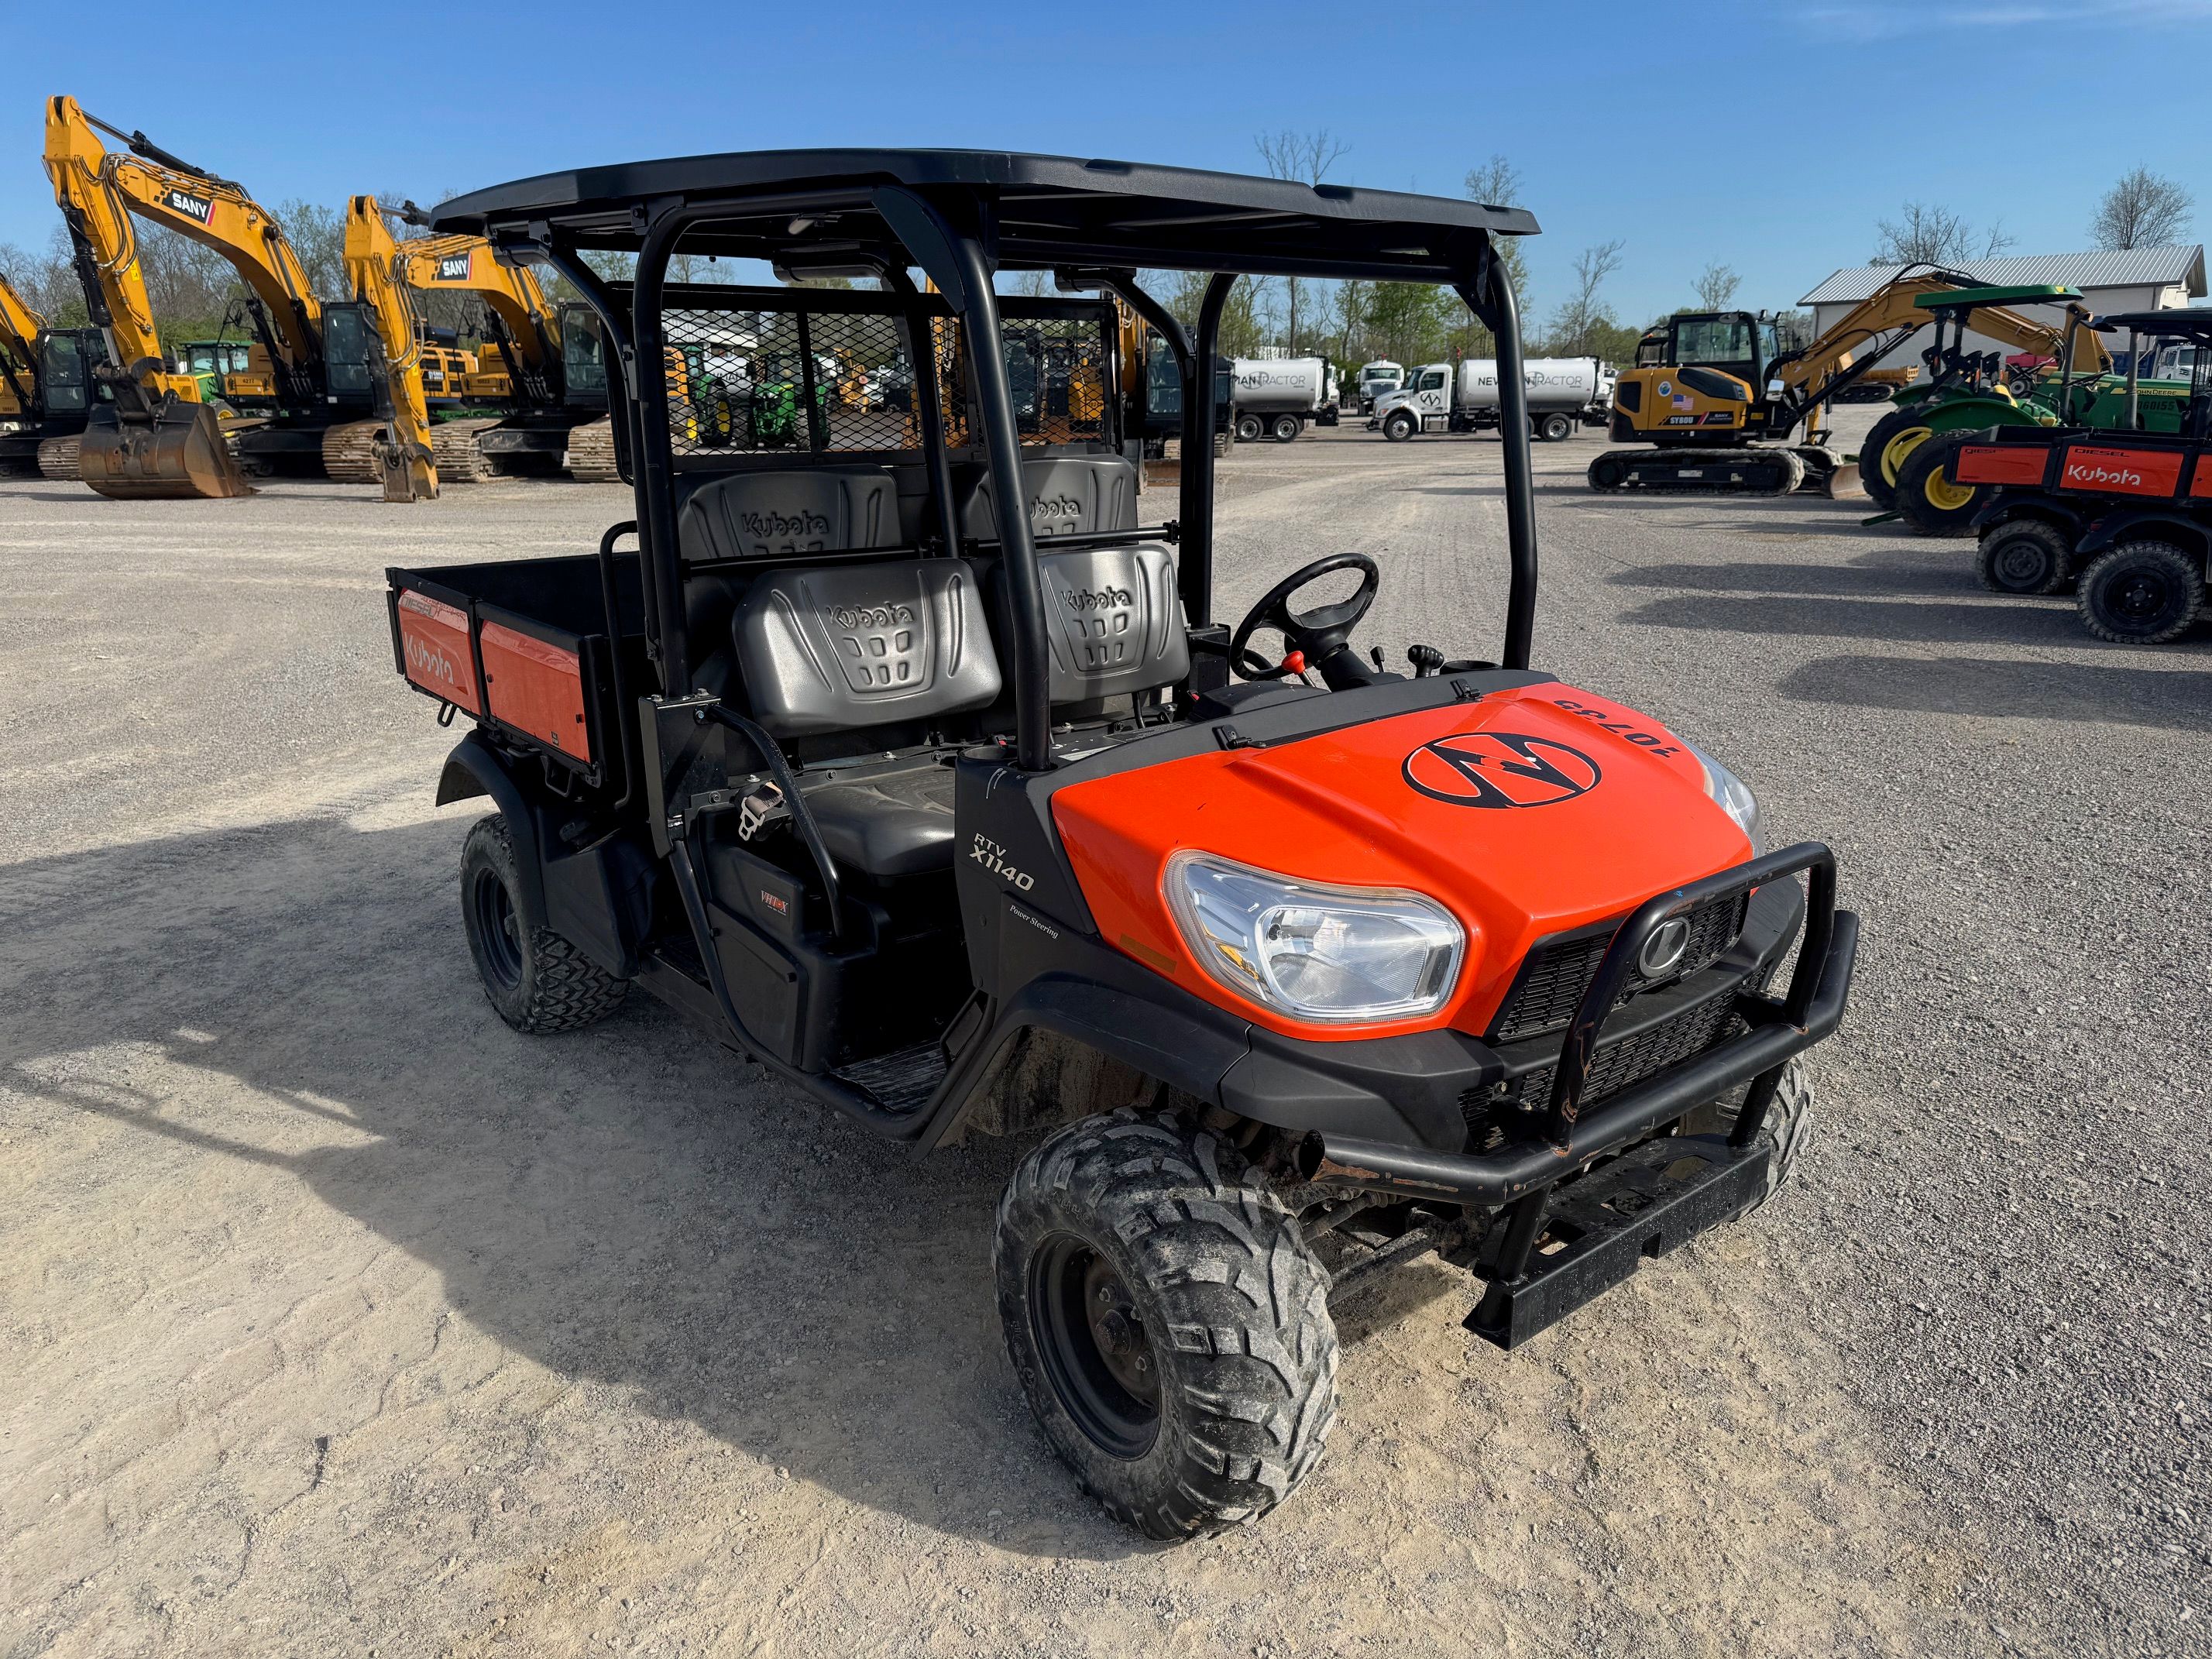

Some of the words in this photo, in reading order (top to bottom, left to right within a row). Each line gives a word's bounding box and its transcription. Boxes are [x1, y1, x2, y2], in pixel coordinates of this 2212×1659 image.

[172, 192, 207, 218] SANY
[442, 259, 467, 276] SANY
[2074, 448, 2131, 458] DIESEL
[2068, 465, 2142, 486] Kubota
[1030, 495, 1081, 520] ubota
[741, 510, 830, 539] Kubota
[1060, 585, 1132, 612] Kubota
[824, 601, 915, 629] Kubota
[404, 630, 455, 685] Kubota
[974, 832, 1007, 857] RTV
[969, 843, 1035, 891] X1140
[1009, 905, 1031, 922] Power
[1029, 917, 1059, 939] Steering
